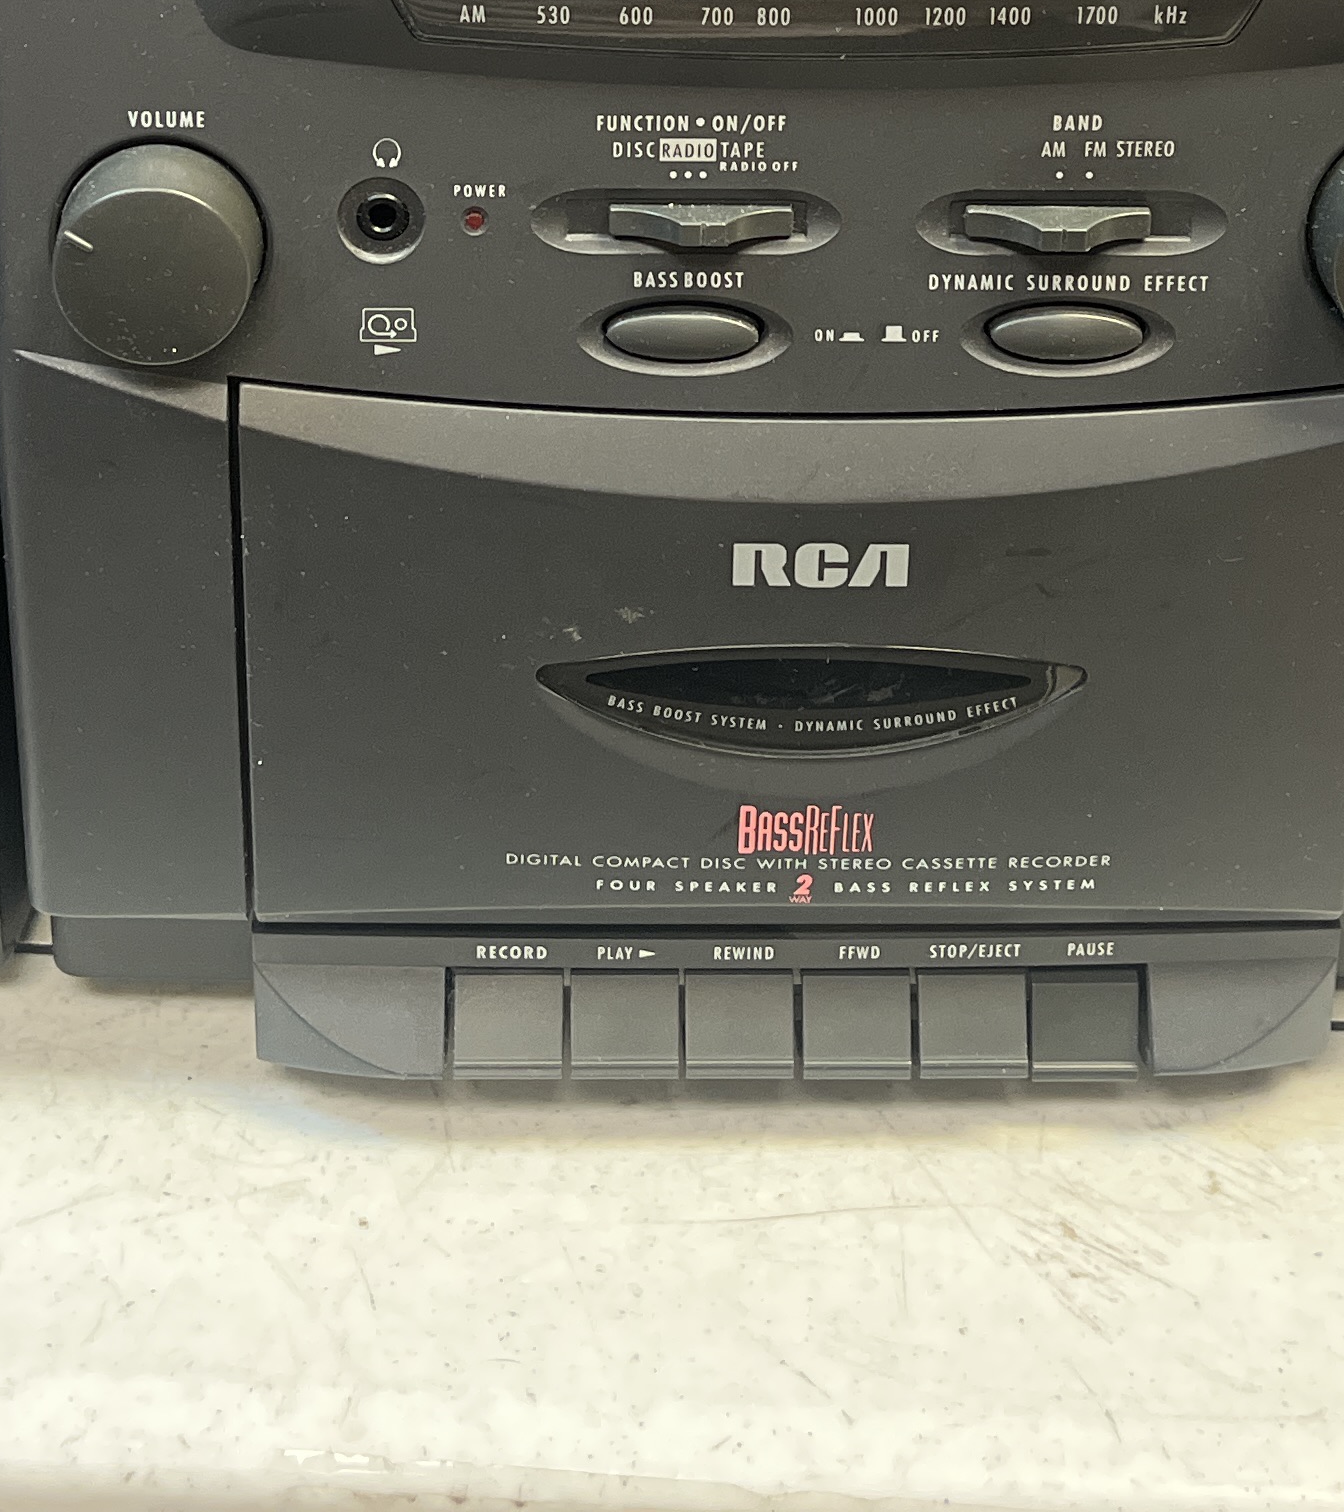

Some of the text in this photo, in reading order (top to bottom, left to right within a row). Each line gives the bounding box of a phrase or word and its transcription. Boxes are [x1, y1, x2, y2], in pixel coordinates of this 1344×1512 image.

[459, 4, 1187, 27] AM 530 600 700 800 1000 1200 1400 1700 kHz
[127, 110, 205, 128] VOLUME
[596, 114, 787, 135] FUNCTION ON/OFF
[1052, 114, 1103, 132] BAND
[612, 141, 765, 159] DISC RADIO TAPE
[1041, 140, 1175, 158] AM FM STEREO
[719, 161, 798, 172] RADIO OFF
[453, 184, 506, 198] POWER
[633, 271, 745, 289] BASS BOOST
[928, 273, 1209, 292] DYNAMIC SURROUND EFFECT
[814, 328, 835, 342] ON
[911, 329, 939, 343] OFF
[732, 542, 910, 589] RCA
[607, 694, 1017, 732] BASS BOOST SYSTEM DYNAMIC SURROUND EFFECT
[505, 853, 1111, 871] DIGITAL COMPACT DISC WITH STEREO CASSETTE RECORDER
[596, 874, 1095, 895] FOUR SPEAKER 2 BASS REFLEX SYSTEM
[788, 895, 813, 904] WAY
[476, 945, 548, 960] RECORD
[597, 946, 633, 961] PLAY
[713, 946, 774, 961] REWIND
[838, 945, 881, 960] FFWD
[929, 943, 1021, 959] STOP/EJECT
[1067, 941, 1115, 957] PAUSE
